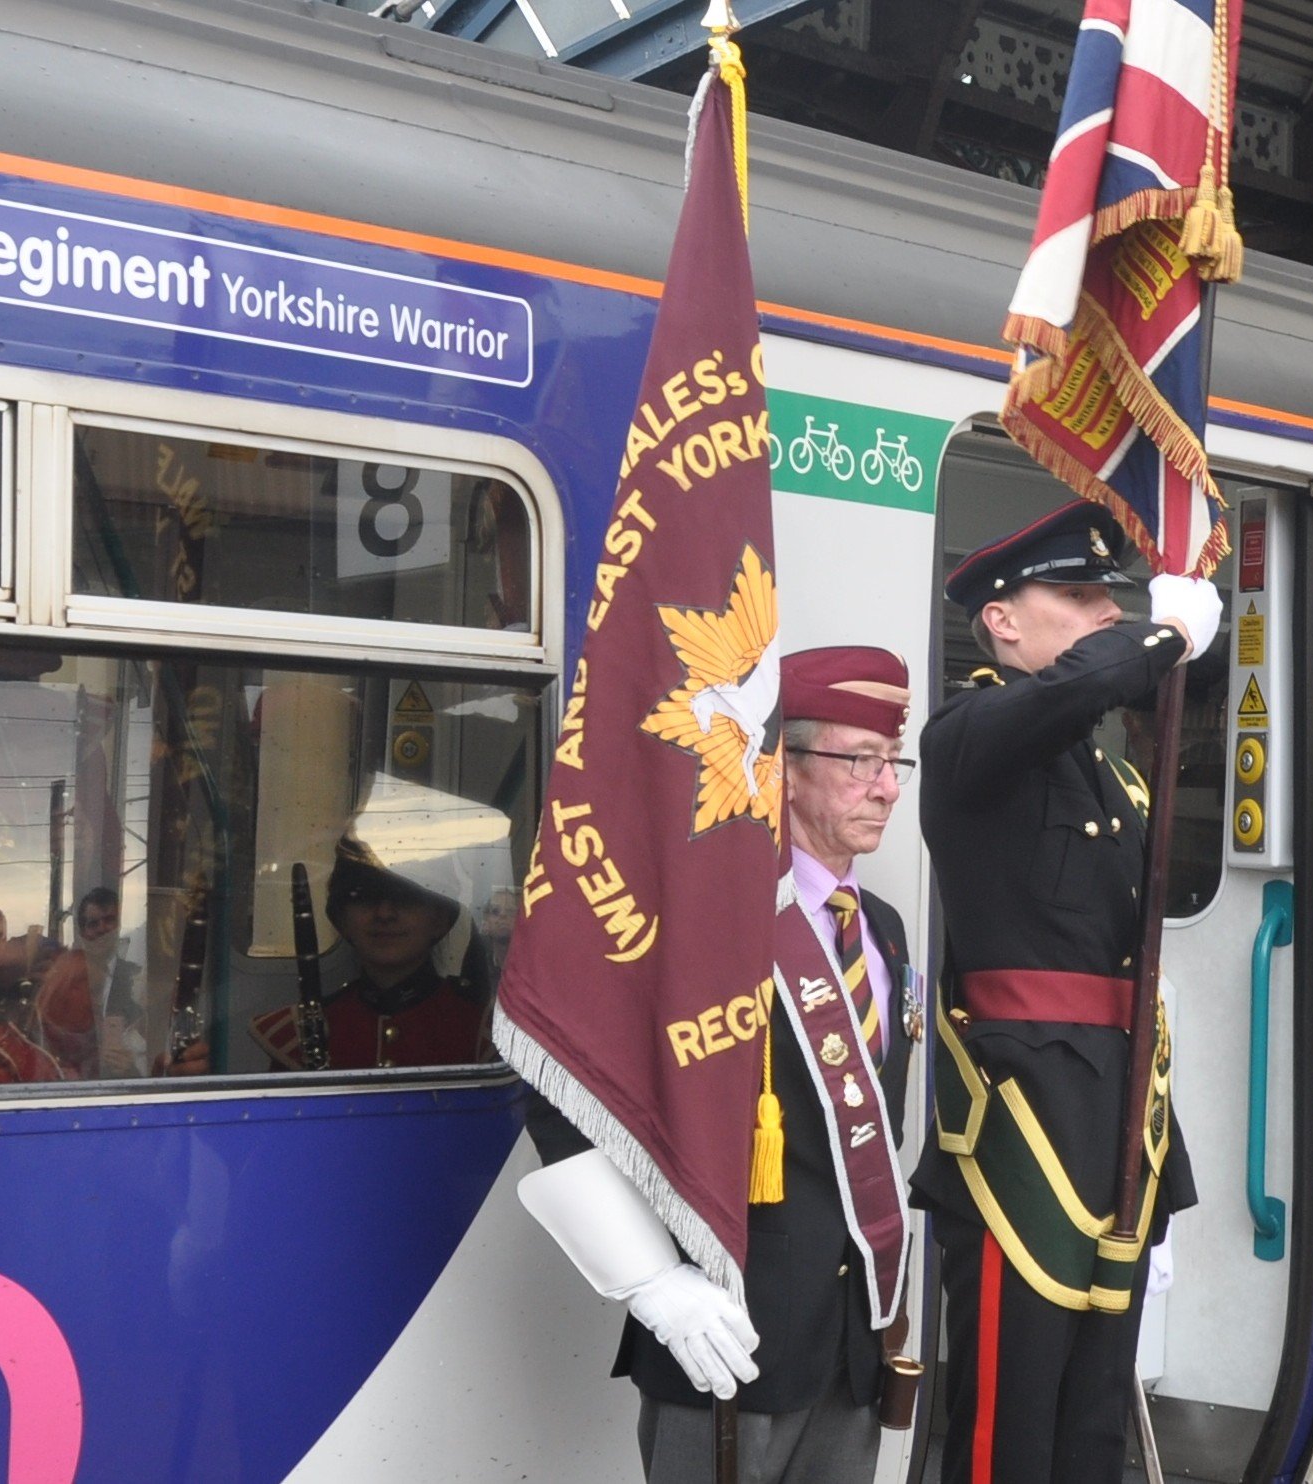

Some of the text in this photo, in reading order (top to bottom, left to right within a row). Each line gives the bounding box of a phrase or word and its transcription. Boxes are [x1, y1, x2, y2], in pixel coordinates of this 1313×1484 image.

[221, 272, 380, 338] Yorkshire
[389, 305, 510, 361] Warrior
[358, 461, 424, 558] 8
[555, 657, 588, 771] AND
[552, 799, 659, 963] (WEST
